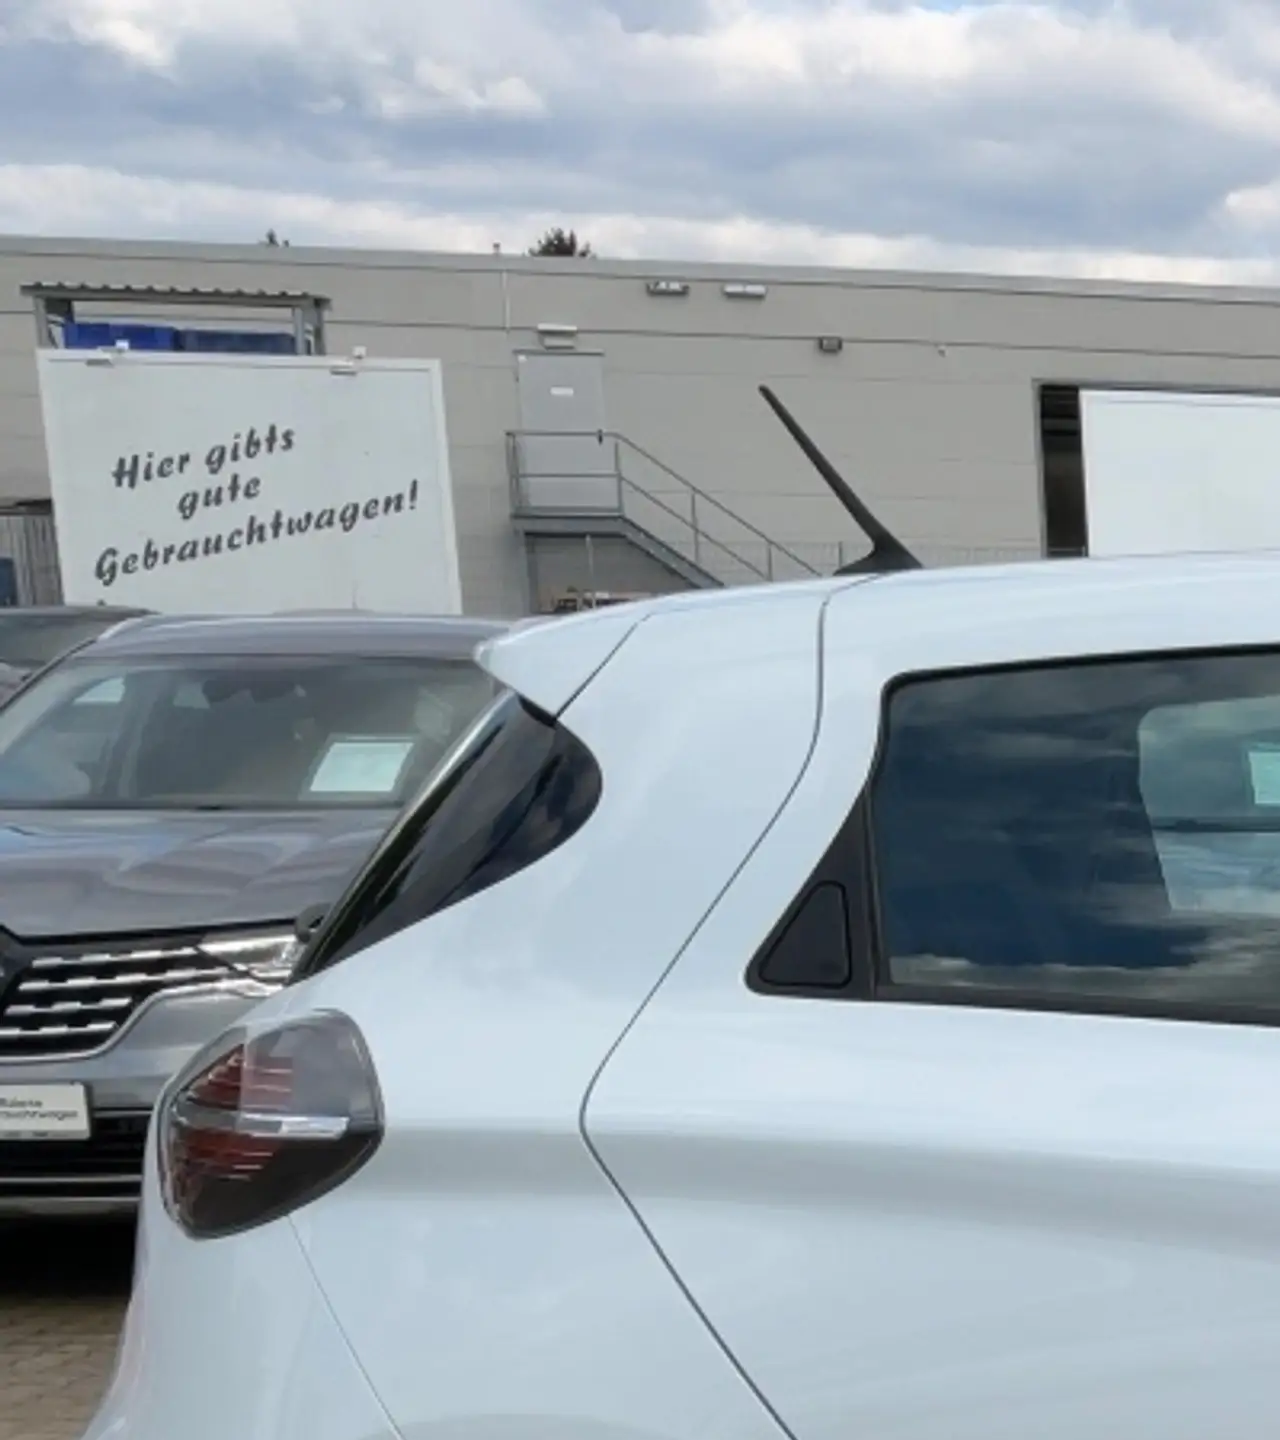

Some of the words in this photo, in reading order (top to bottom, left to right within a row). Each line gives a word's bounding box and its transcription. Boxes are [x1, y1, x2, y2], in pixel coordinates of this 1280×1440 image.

[111, 451, 191, 490] Hier
[204, 424, 296, 475] gibts
[176, 473, 262, 520] gute
[94, 478, 419, 587] Gebrauchtwagen!
